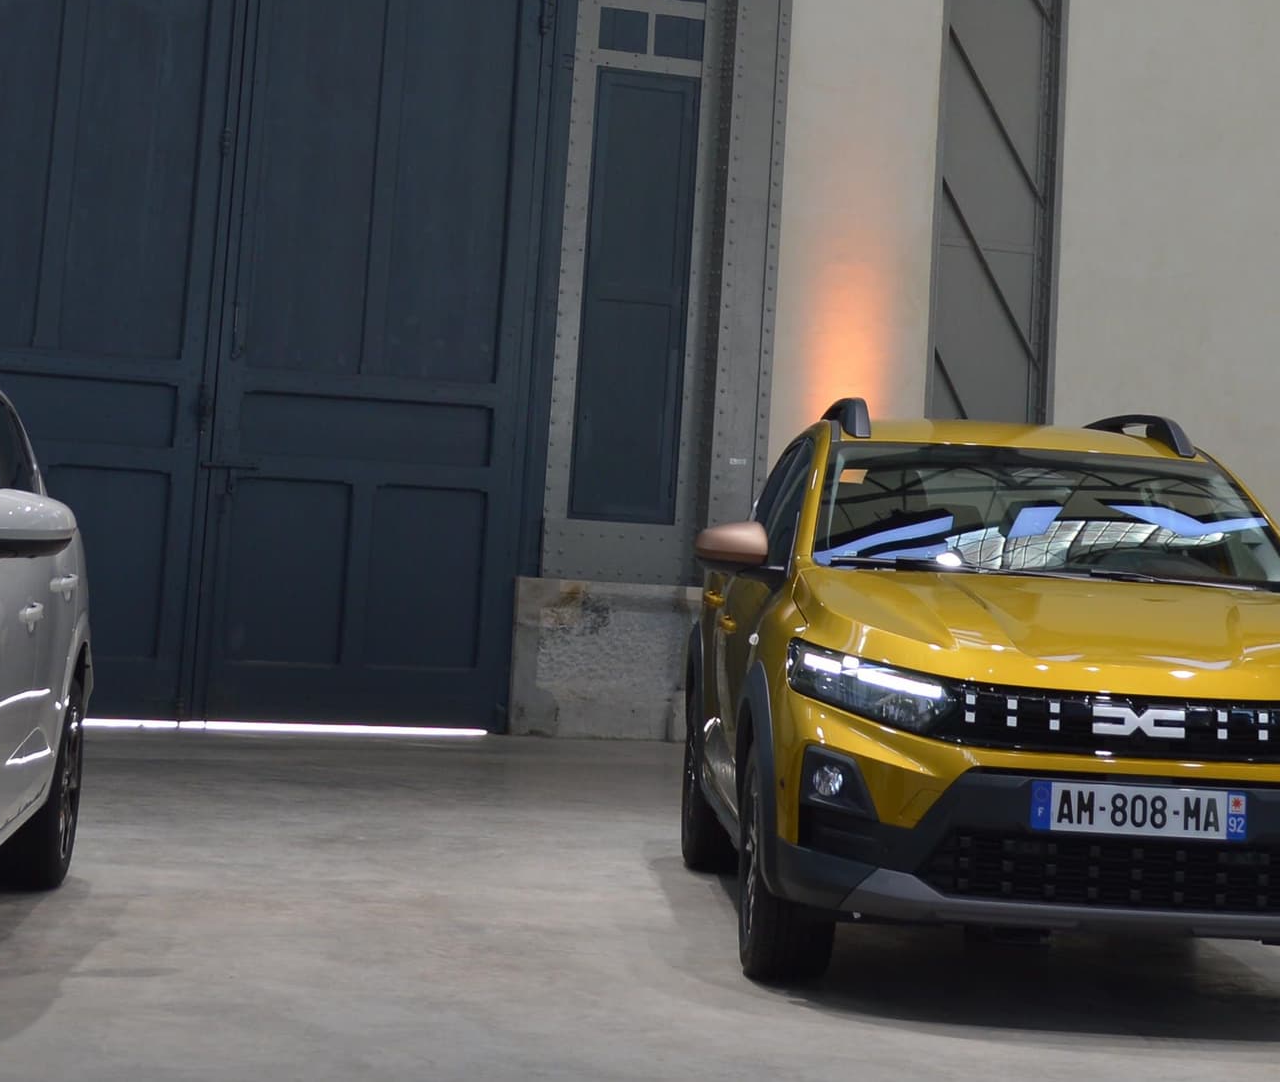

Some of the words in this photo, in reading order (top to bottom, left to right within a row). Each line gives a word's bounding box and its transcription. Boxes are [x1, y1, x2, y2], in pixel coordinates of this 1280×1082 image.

[1037, 806, 1045, 817] F
[1056, 789, 1220, 832] AM-808-MA
[1228, 816, 1245, 834] 92
